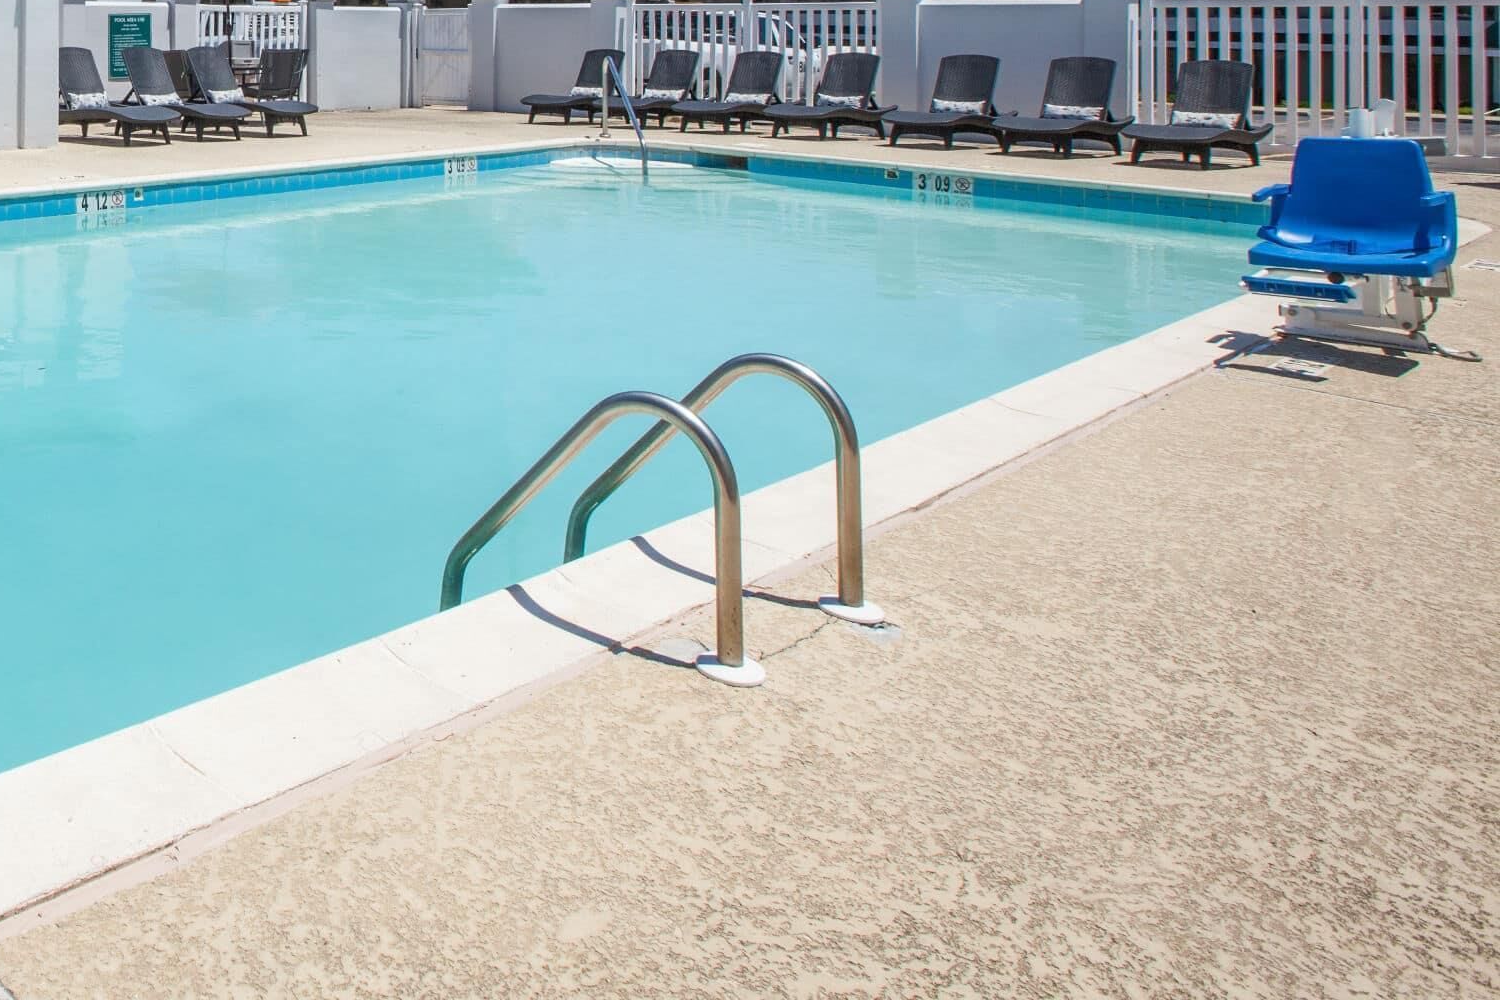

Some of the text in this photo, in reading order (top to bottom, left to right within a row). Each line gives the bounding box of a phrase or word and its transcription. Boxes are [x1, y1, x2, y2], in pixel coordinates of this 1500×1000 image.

[918, 174, 950, 193] 3 0.9
[81, 191, 108, 212] 4 1.2
